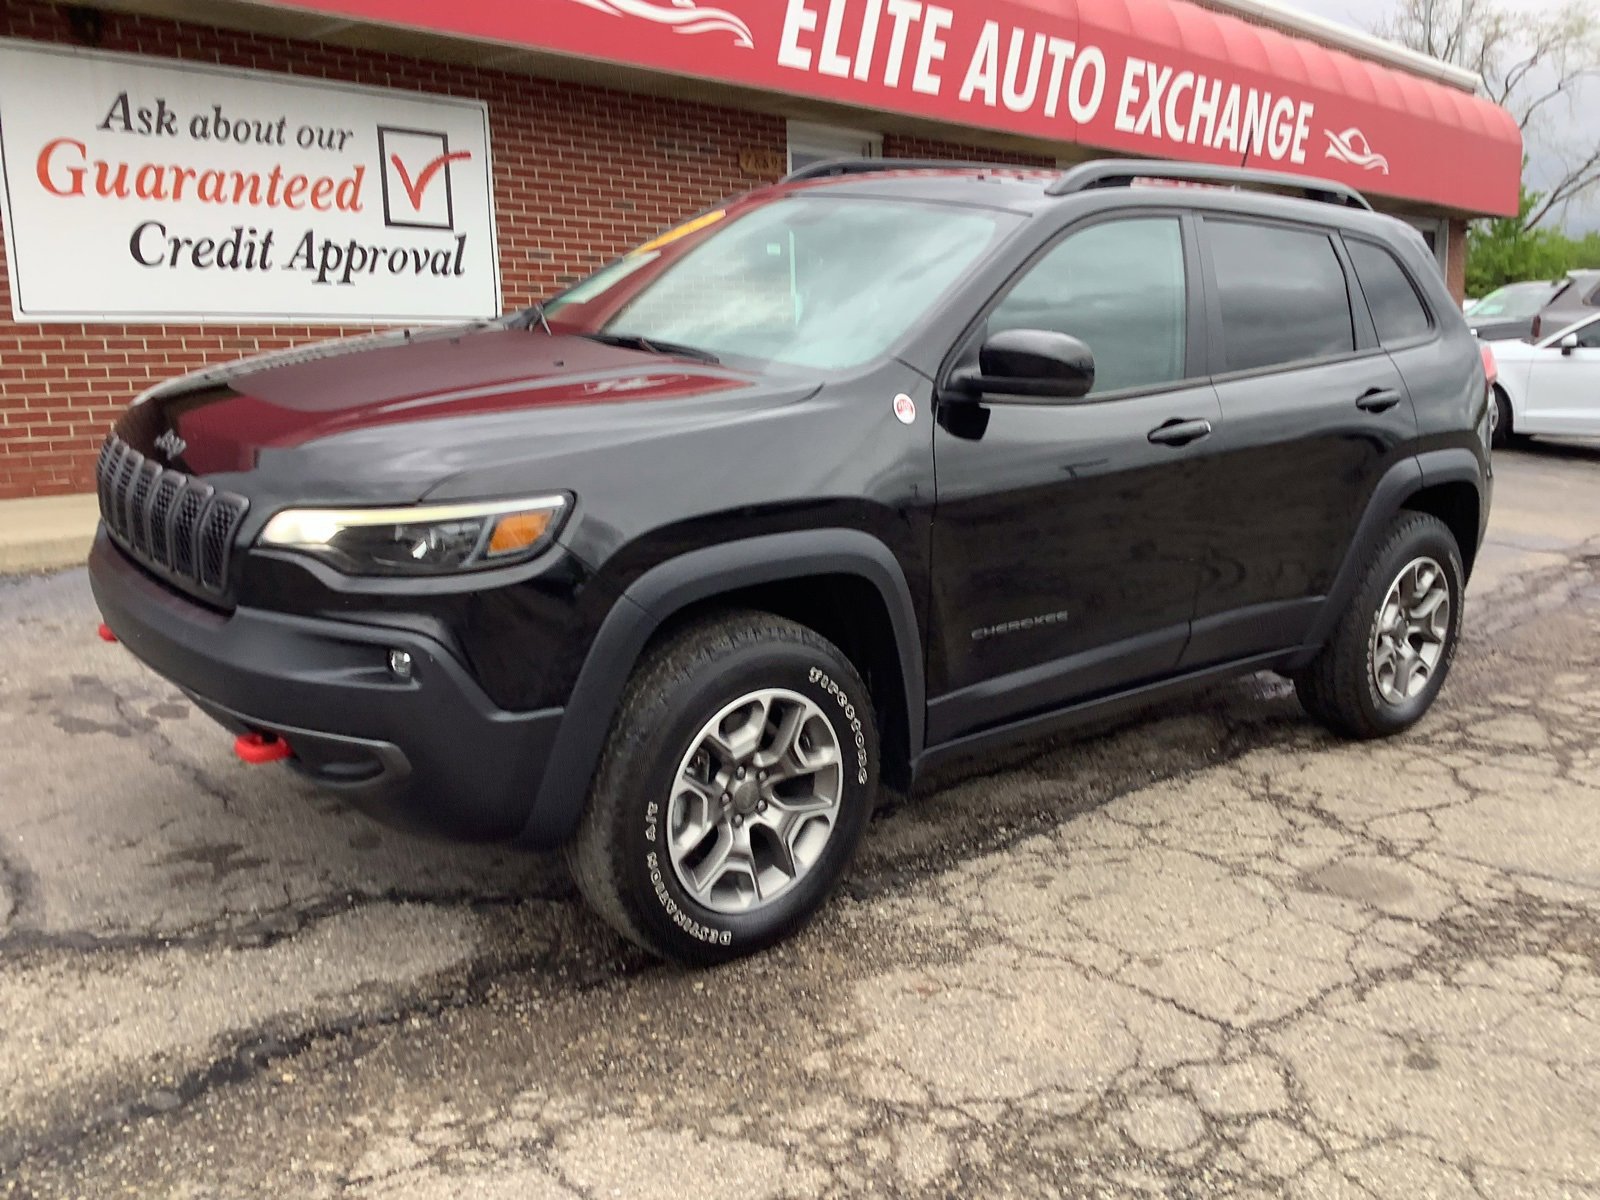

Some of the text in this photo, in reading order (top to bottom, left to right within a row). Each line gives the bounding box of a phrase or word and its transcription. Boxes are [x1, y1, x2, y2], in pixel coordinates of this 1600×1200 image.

[777, 0, 1315, 165] ELITE AUTO EXCHANGE
[96, 91, 355, 152] Ask about our
[36, 136, 367, 213] Guaranteed
[129, 219, 468, 286] Credit Approval
[646, 851, 732, 946] DESTINATION
